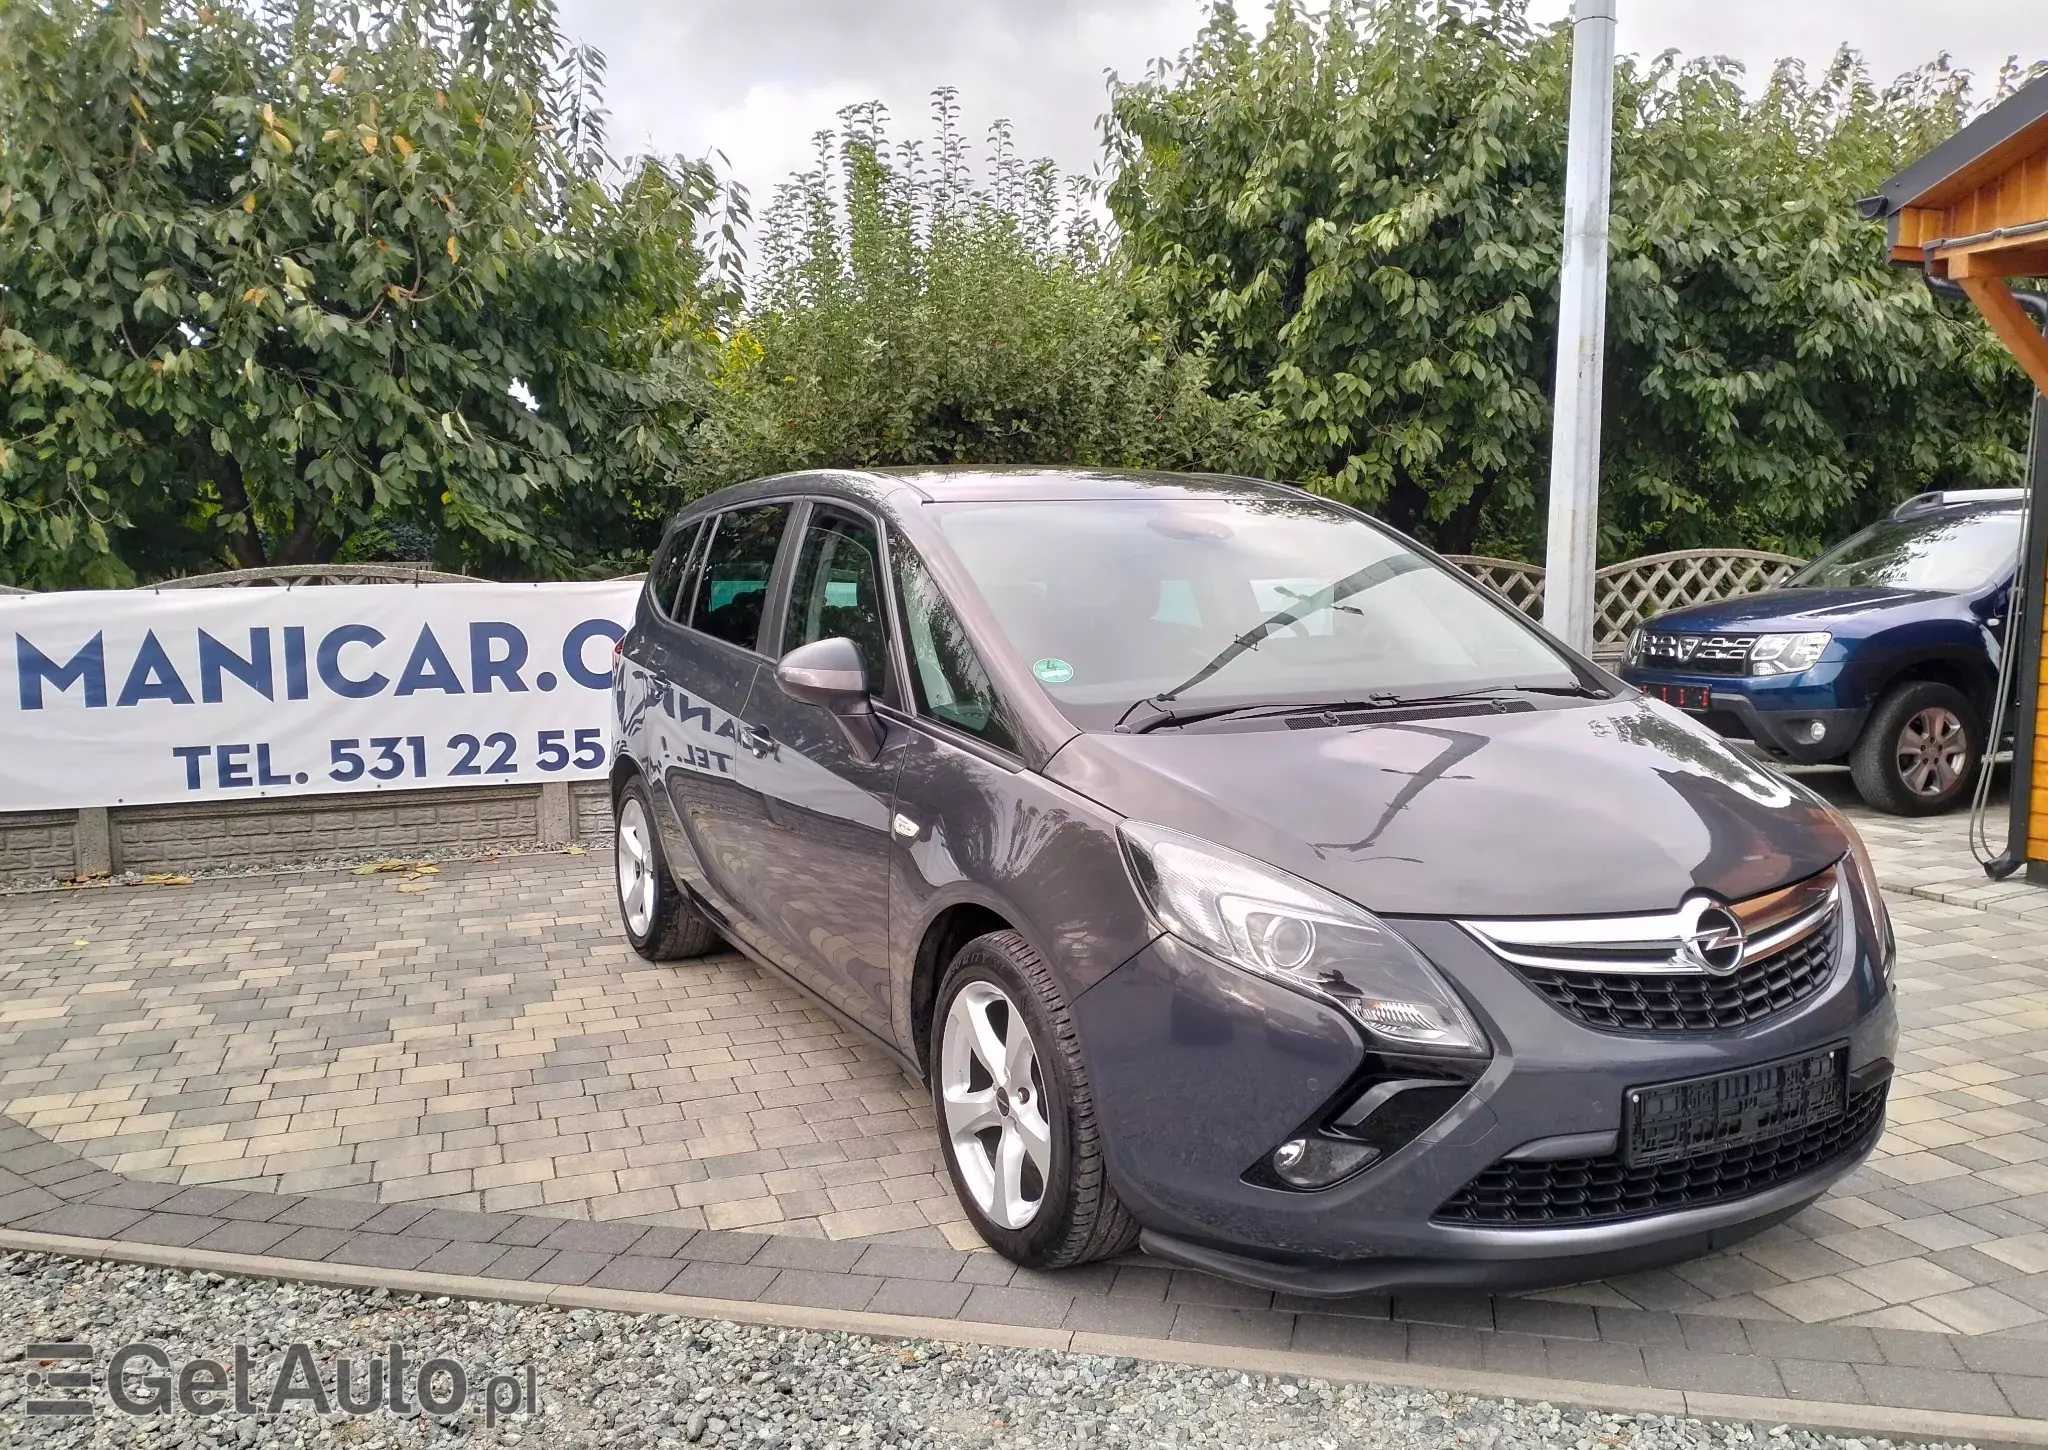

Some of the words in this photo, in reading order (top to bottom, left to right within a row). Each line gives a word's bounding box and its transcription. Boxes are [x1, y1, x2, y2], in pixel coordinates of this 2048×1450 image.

[173, 743, 309, 790] TEL.
[329, 736, 427, 782] 531
[447, 732, 517, 775] 22
[536, 728, 606, 772] 55
